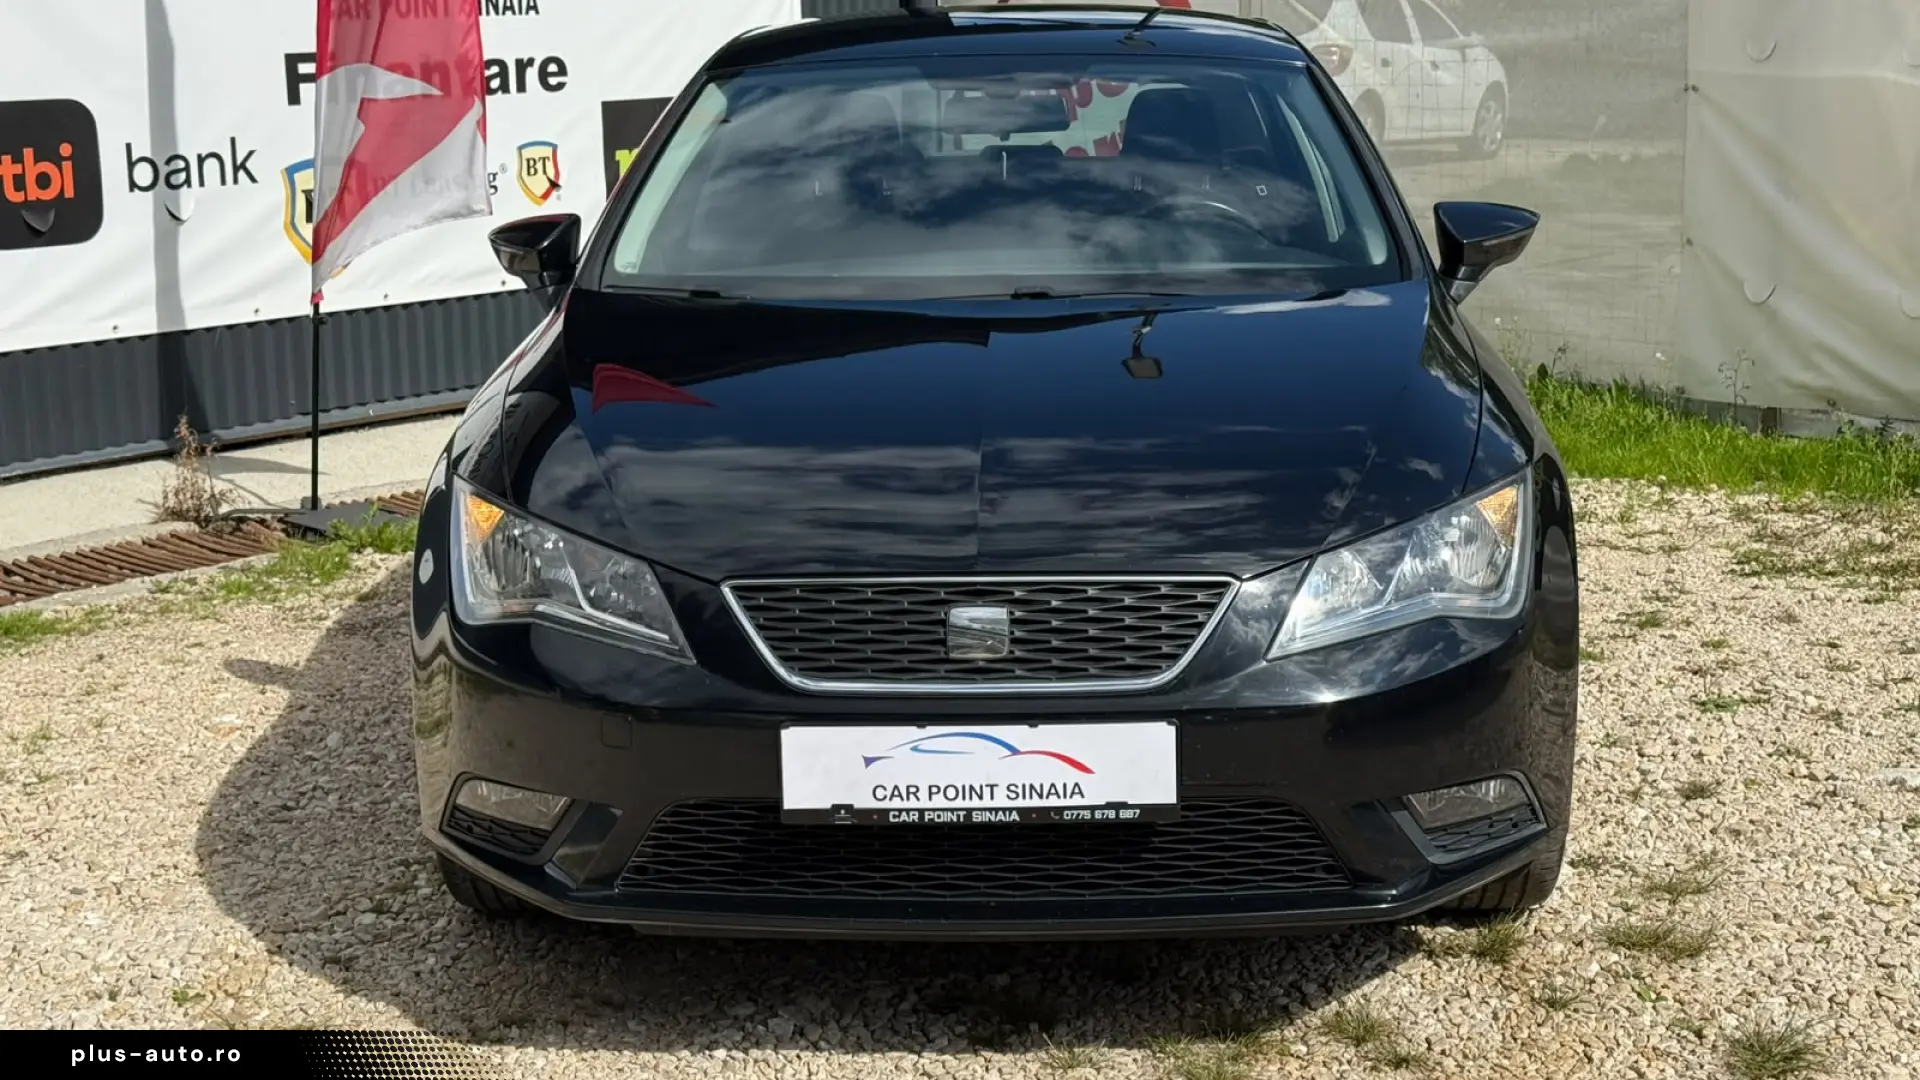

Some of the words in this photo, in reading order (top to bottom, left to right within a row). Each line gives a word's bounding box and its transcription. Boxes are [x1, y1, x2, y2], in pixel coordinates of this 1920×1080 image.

[0, 143, 75, 203] tbi
[125, 136, 259, 193] bank
[525, 156, 551, 177] BT
[872, 784, 920, 802] CAR
[928, 783, 999, 802] POINT
[1006, 782, 1085, 801] SINAIA
[888, 810, 919, 823] CAR
[924, 810, 967, 823] POINT
[972, 810, 1020, 822] SINAIA
[1063, 809, 1092, 820] 0775
